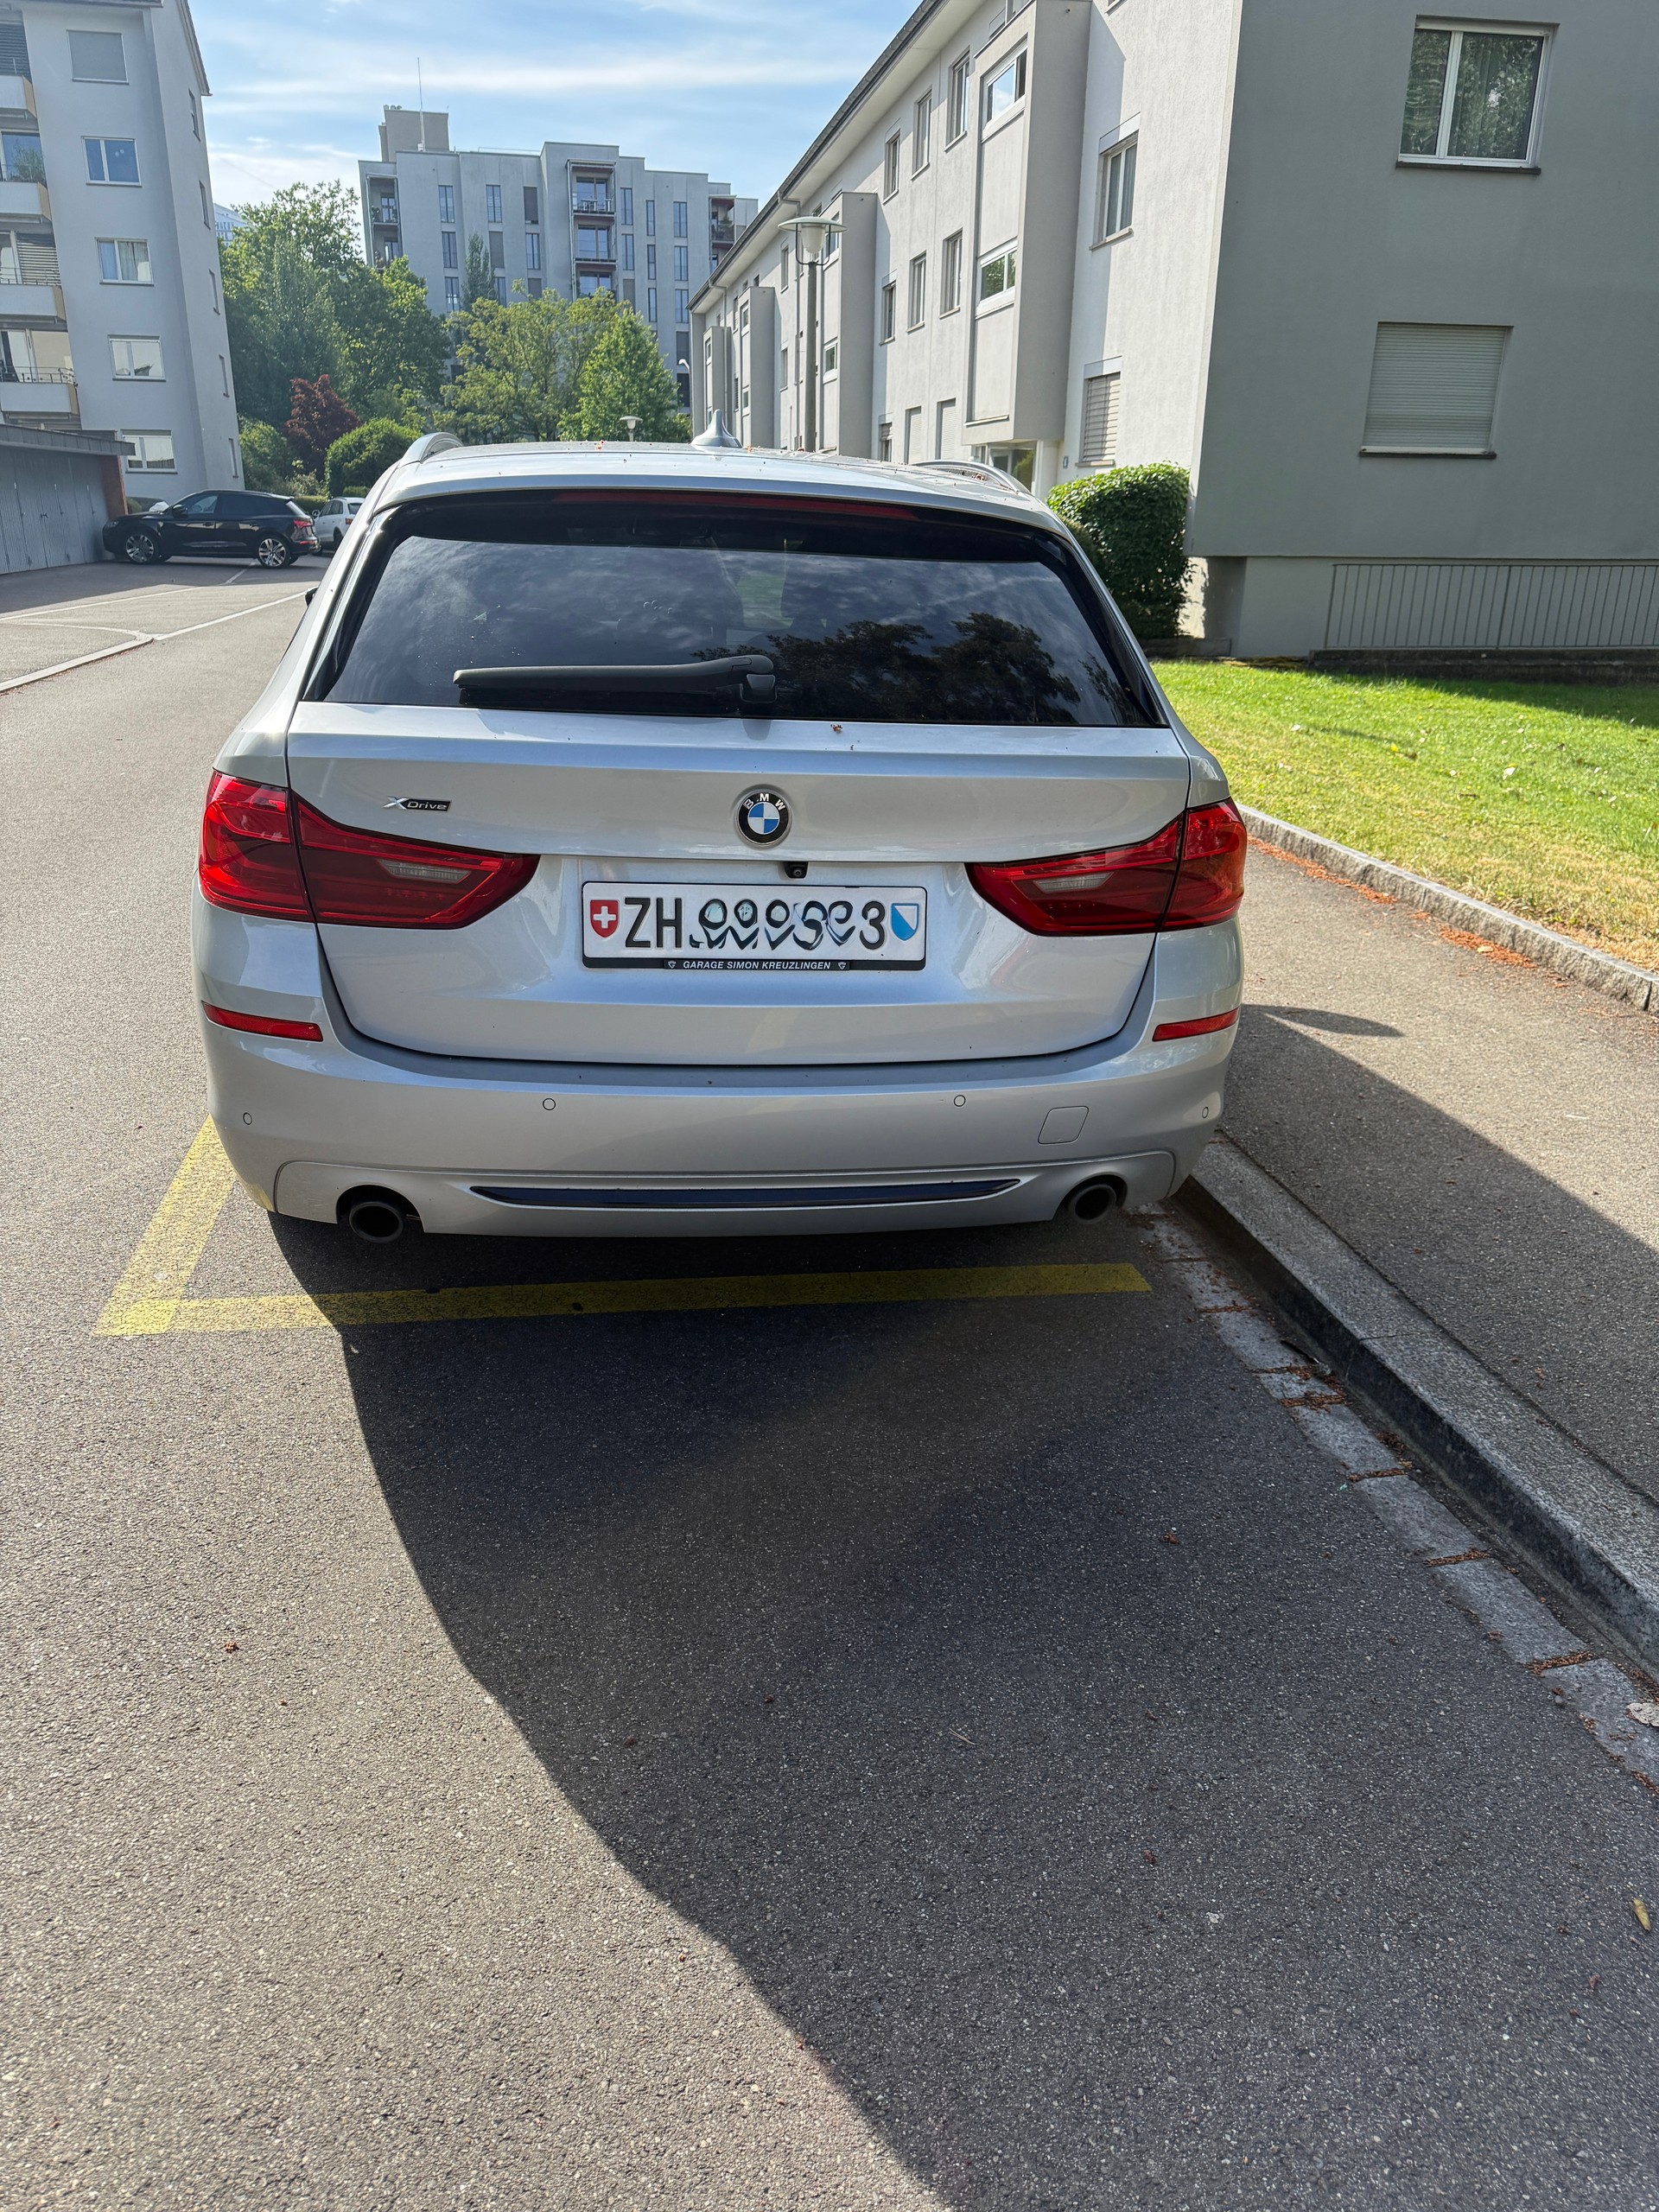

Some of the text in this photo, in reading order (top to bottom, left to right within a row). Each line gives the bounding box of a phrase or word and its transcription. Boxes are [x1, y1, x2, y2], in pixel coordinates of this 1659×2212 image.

[743, 792, 785, 810] BMW
[683, 960, 724, 969] GARAGE
[761, 961, 831, 969] KREUZLINGEN
